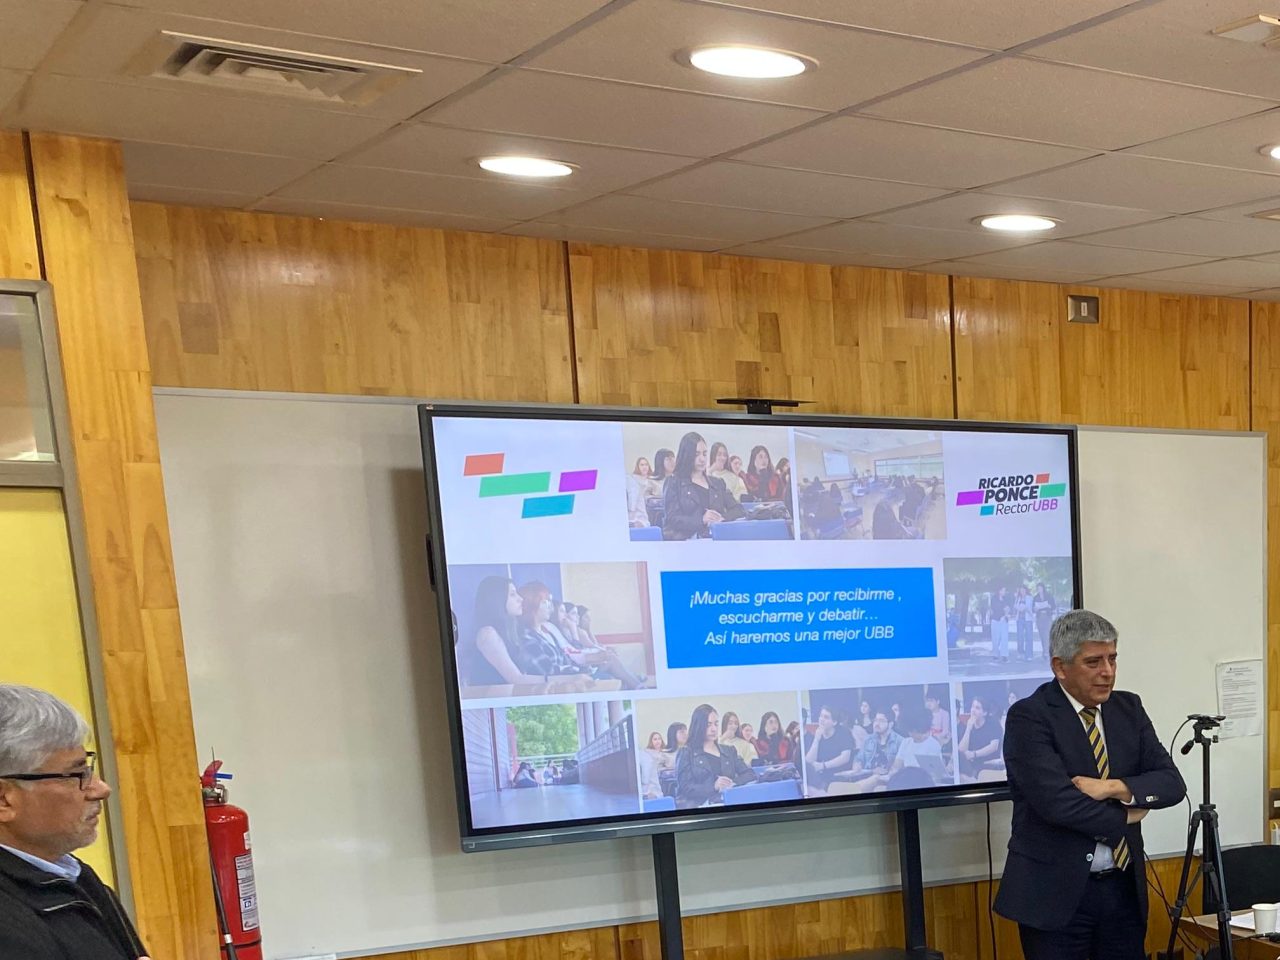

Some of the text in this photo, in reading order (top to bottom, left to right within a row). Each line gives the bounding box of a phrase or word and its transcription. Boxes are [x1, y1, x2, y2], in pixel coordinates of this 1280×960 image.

[978, 474, 1034, 489] RICARDO
[984, 485, 1039, 503] PONCE
[996, 499, 1058, 515] RectorUBB
[690, 590, 750, 608] ¡Muchas
[754, 590, 803, 607] gracias
[806, 590, 830, 606] por
[834, 588, 894, 601] recibirme
[719, 610, 804, 625] escucharme
[806, 611, 816, 625] y
[704, 625, 895, 645] Así haremos una mejor UBB
